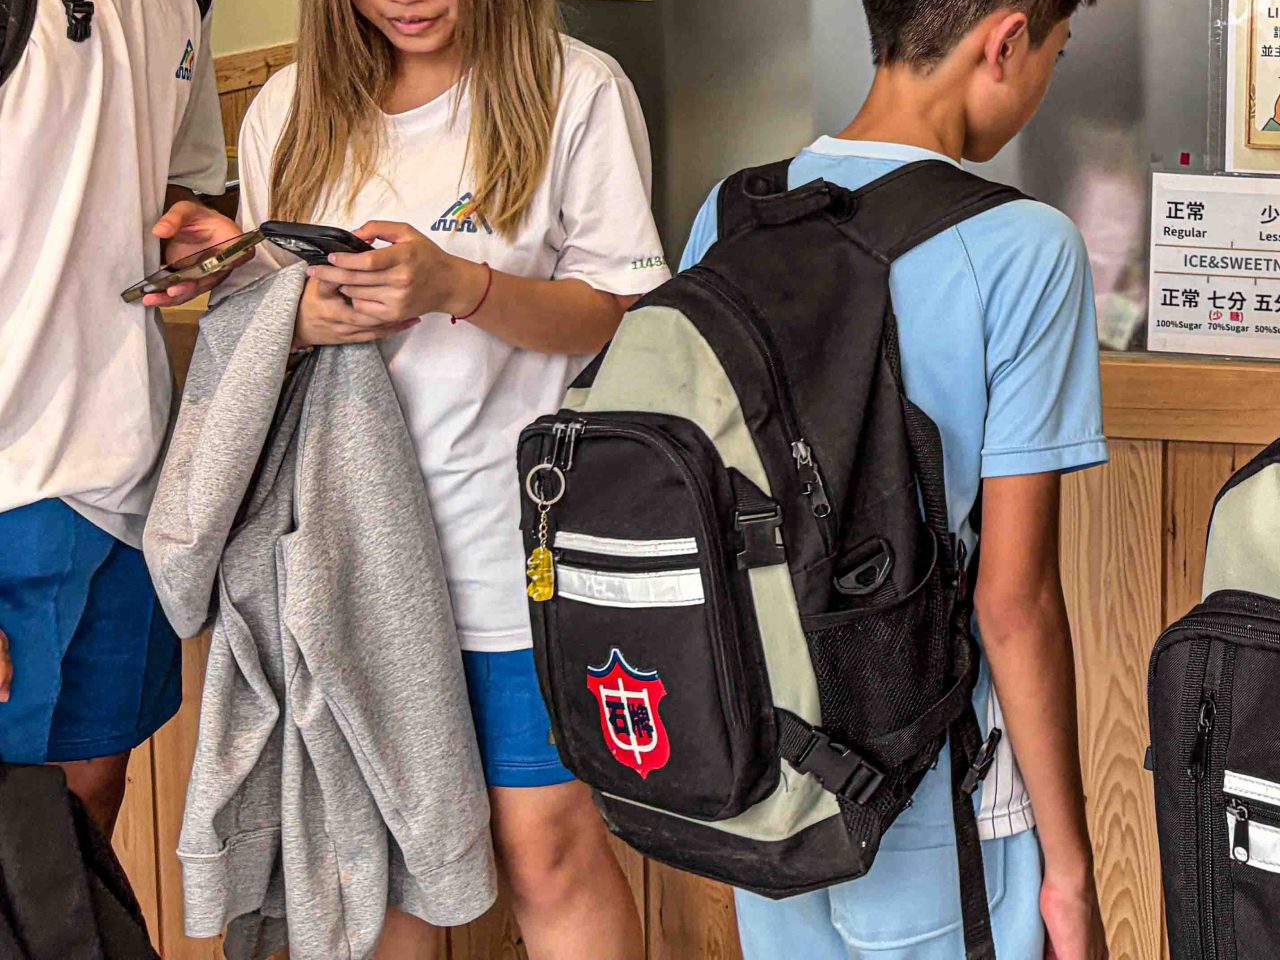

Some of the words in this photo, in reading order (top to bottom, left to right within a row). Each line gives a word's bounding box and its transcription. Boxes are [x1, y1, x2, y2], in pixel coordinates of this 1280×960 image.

[1166, 201, 1205, 221] 正常
[1164, 227, 1207, 239] Regular
[1161, 288, 1200, 308] 正常
[1208, 291, 1246, 311] 七分
[1156, 320, 1202, 330] 100%Sugar
[1208, 322, 1249, 333] 70%Sugar
